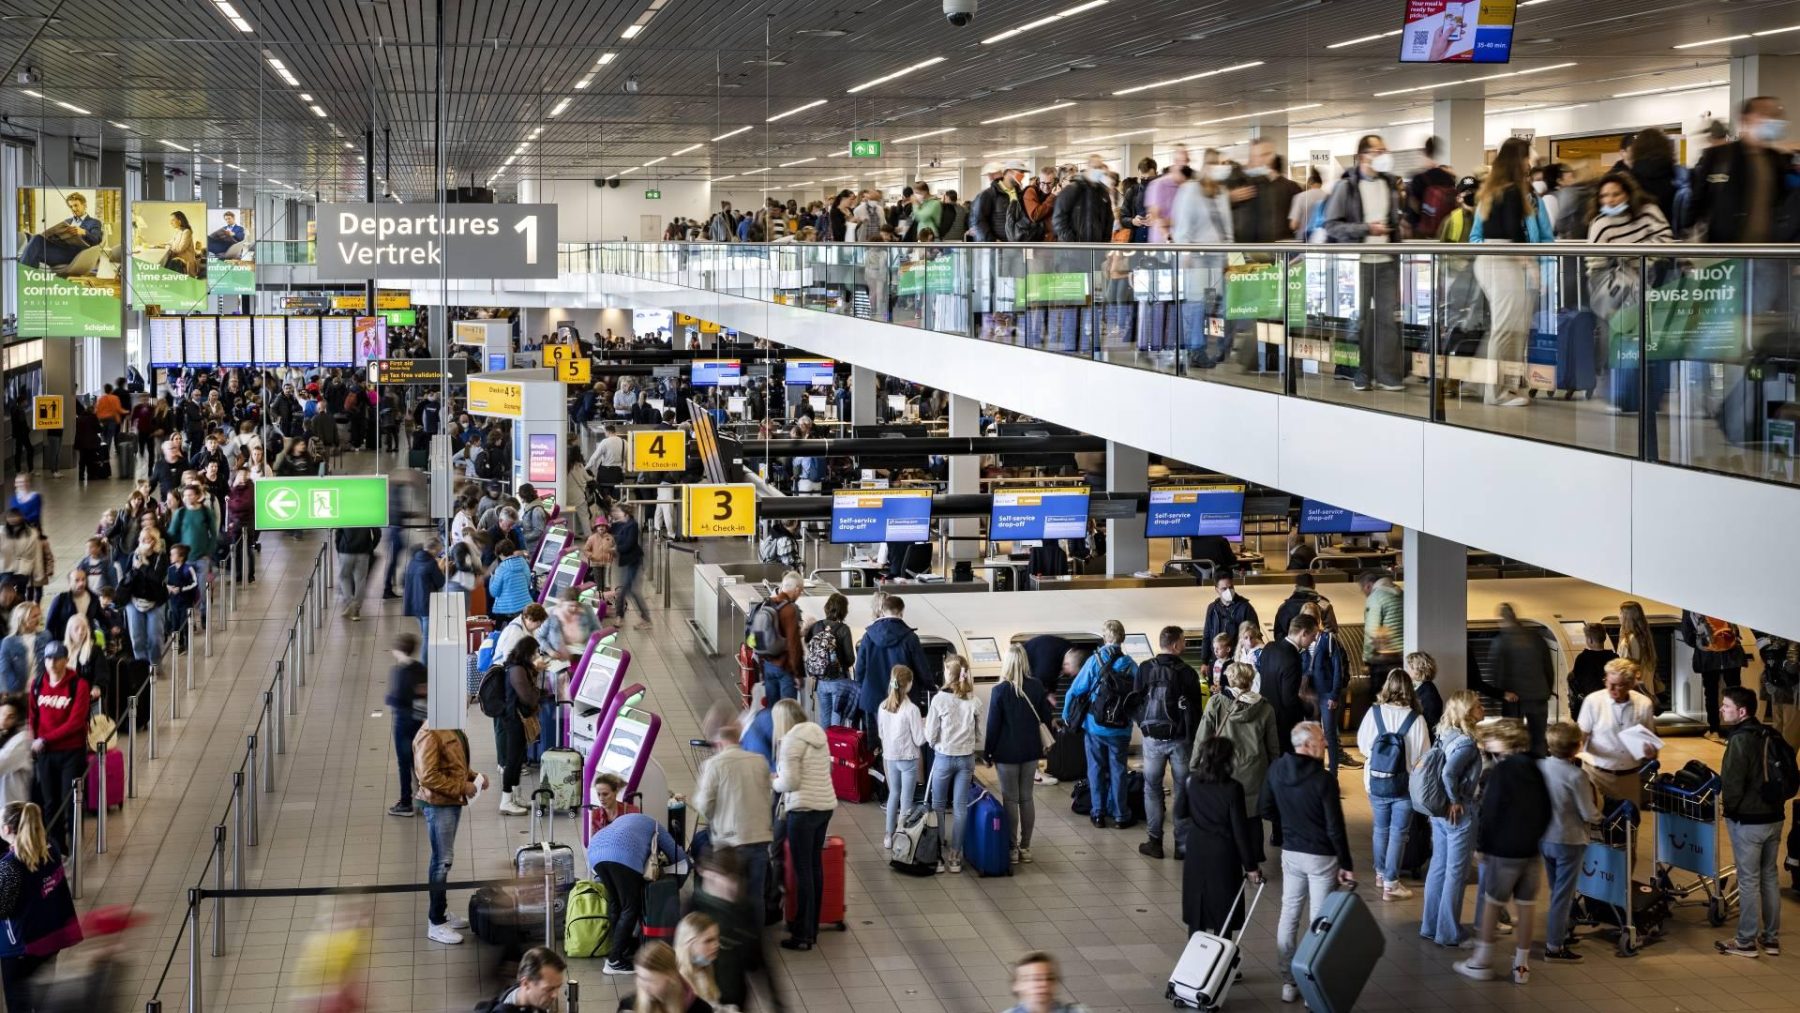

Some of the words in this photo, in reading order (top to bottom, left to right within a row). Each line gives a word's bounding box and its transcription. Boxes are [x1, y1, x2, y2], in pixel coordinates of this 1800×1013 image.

[339, 212, 500, 240] Departures
[513, 215, 537, 265] 1
[338, 241, 441, 265] Vertrek
[136, 261, 161, 271] Your
[24, 269, 57, 282] Your
[136, 272, 160, 281] time
[161, 273, 189, 281] saver
[24, 283, 80, 296] comfort
[81, 287, 115, 297] zone
[553, 346, 562, 360] 6
[569, 361, 579, 376] 5
[504, 386, 510, 398] 4
[510, 387, 516, 397] 5
[648, 435, 667, 459] 4
[713, 490, 733, 521] 3
[1153, 518, 1182, 526] drop-off
[1307, 514, 1335, 522] drop-off
[712, 524, 746, 532] Check-in
[838, 523, 867, 531] drop-off
[997, 521, 1026, 529] drop-off
